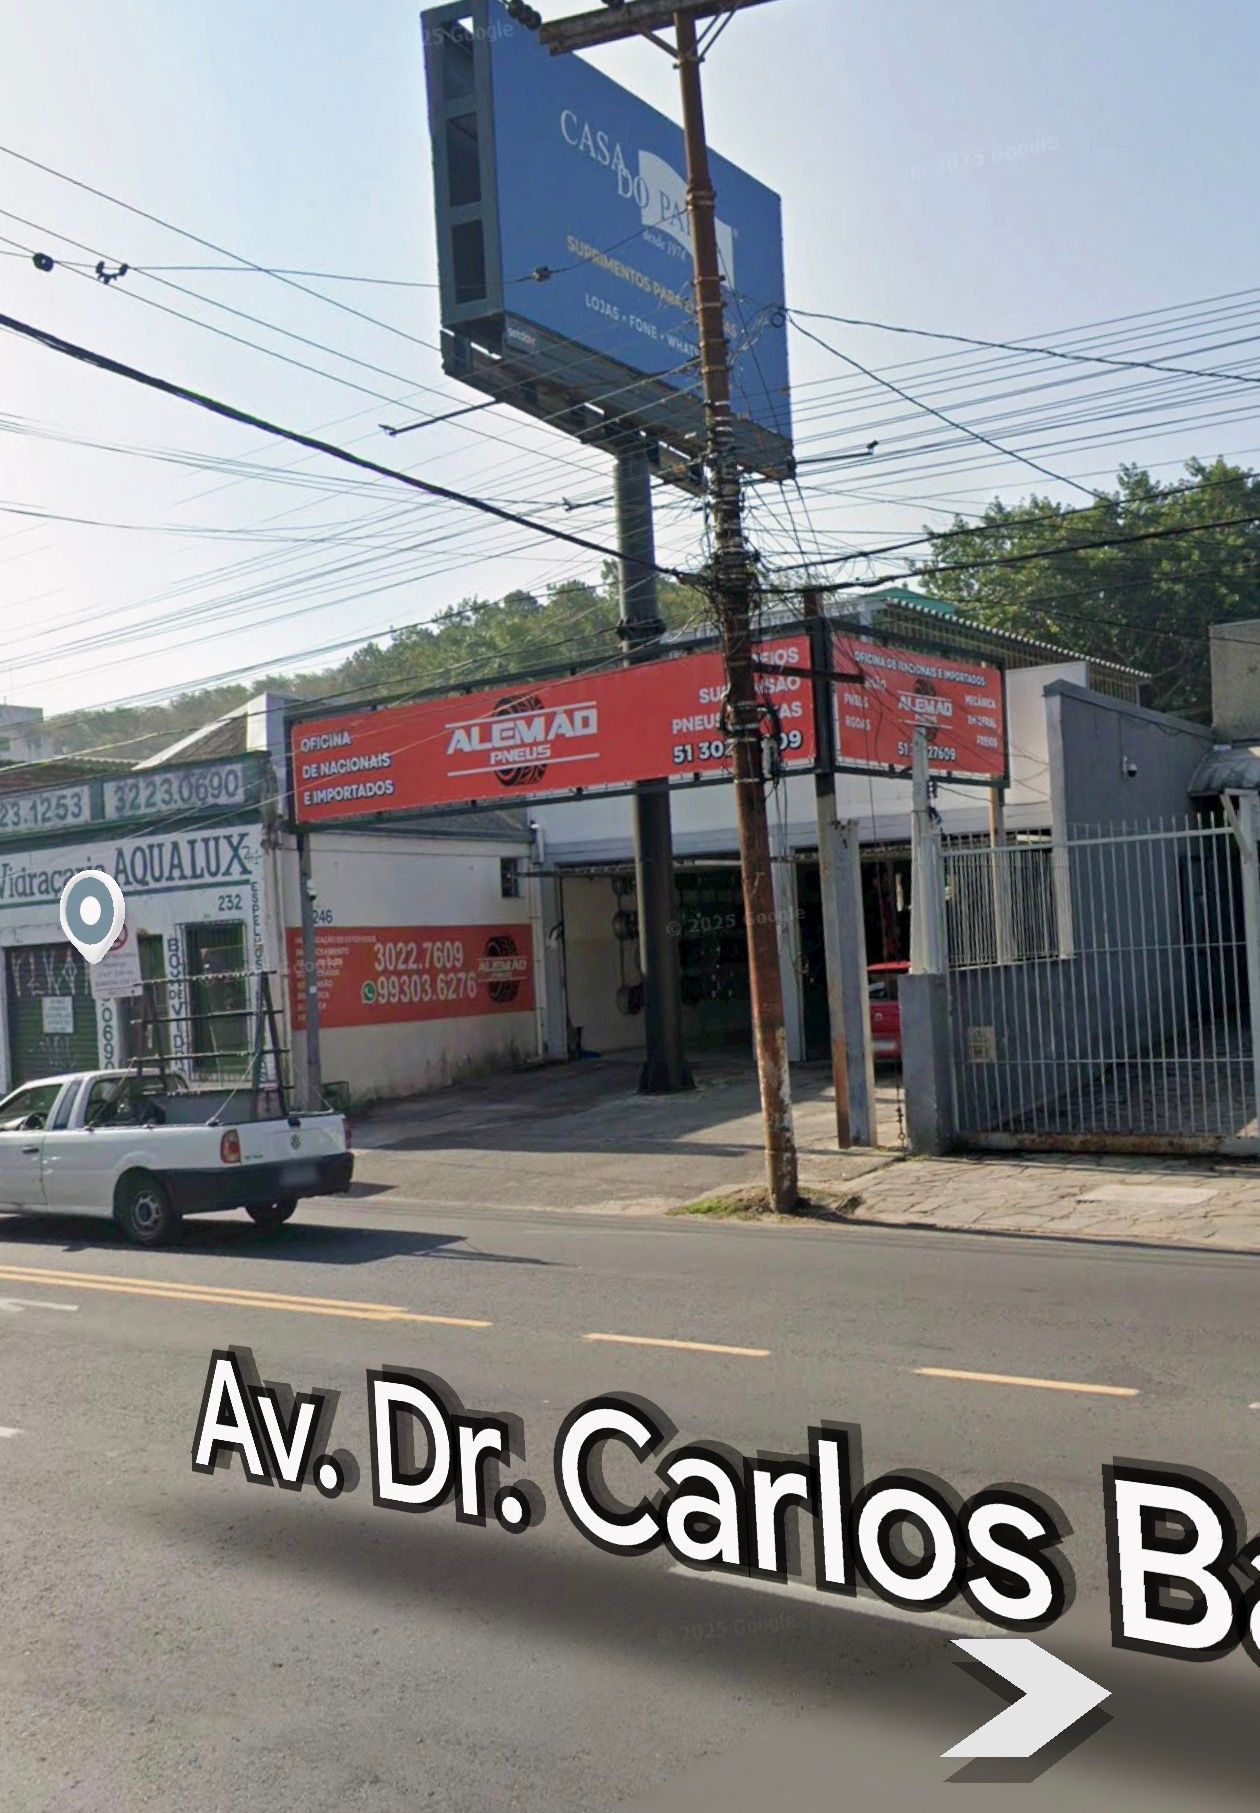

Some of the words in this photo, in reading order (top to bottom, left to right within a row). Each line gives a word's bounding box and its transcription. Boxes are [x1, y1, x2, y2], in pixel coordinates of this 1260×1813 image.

[560, 110, 625, 171] CASA
[617, 165, 650, 209] DO
[566, 234, 650, 293] SUPRIMENTOS
[585, 293, 620, 321] LOJAS
[628, 314, 658, 341] FONE
[854, 650, 886, 668] OFICINA
[301, 730, 352, 753] OFICINA
[490, 744, 552, 765] PNEUS
[673, 745, 694, 764] 51
[898, 741, 908, 756] 51
[302, 764, 319, 779] DE
[320, 751, 392, 777] NACIONAIS
[114, 769, 240, 813] 3223.0690
[303, 790, 312, 806] E
[313, 779, 395, 805] IMPORTADOS
[113, 833, 253, 887] AQUALUX
[218, 894, 243, 911] 232
[312, 909, 333, 924] 246
[374, 941, 464, 971] 3022.7609
[377, 972, 478, 1004] 99303.6276
